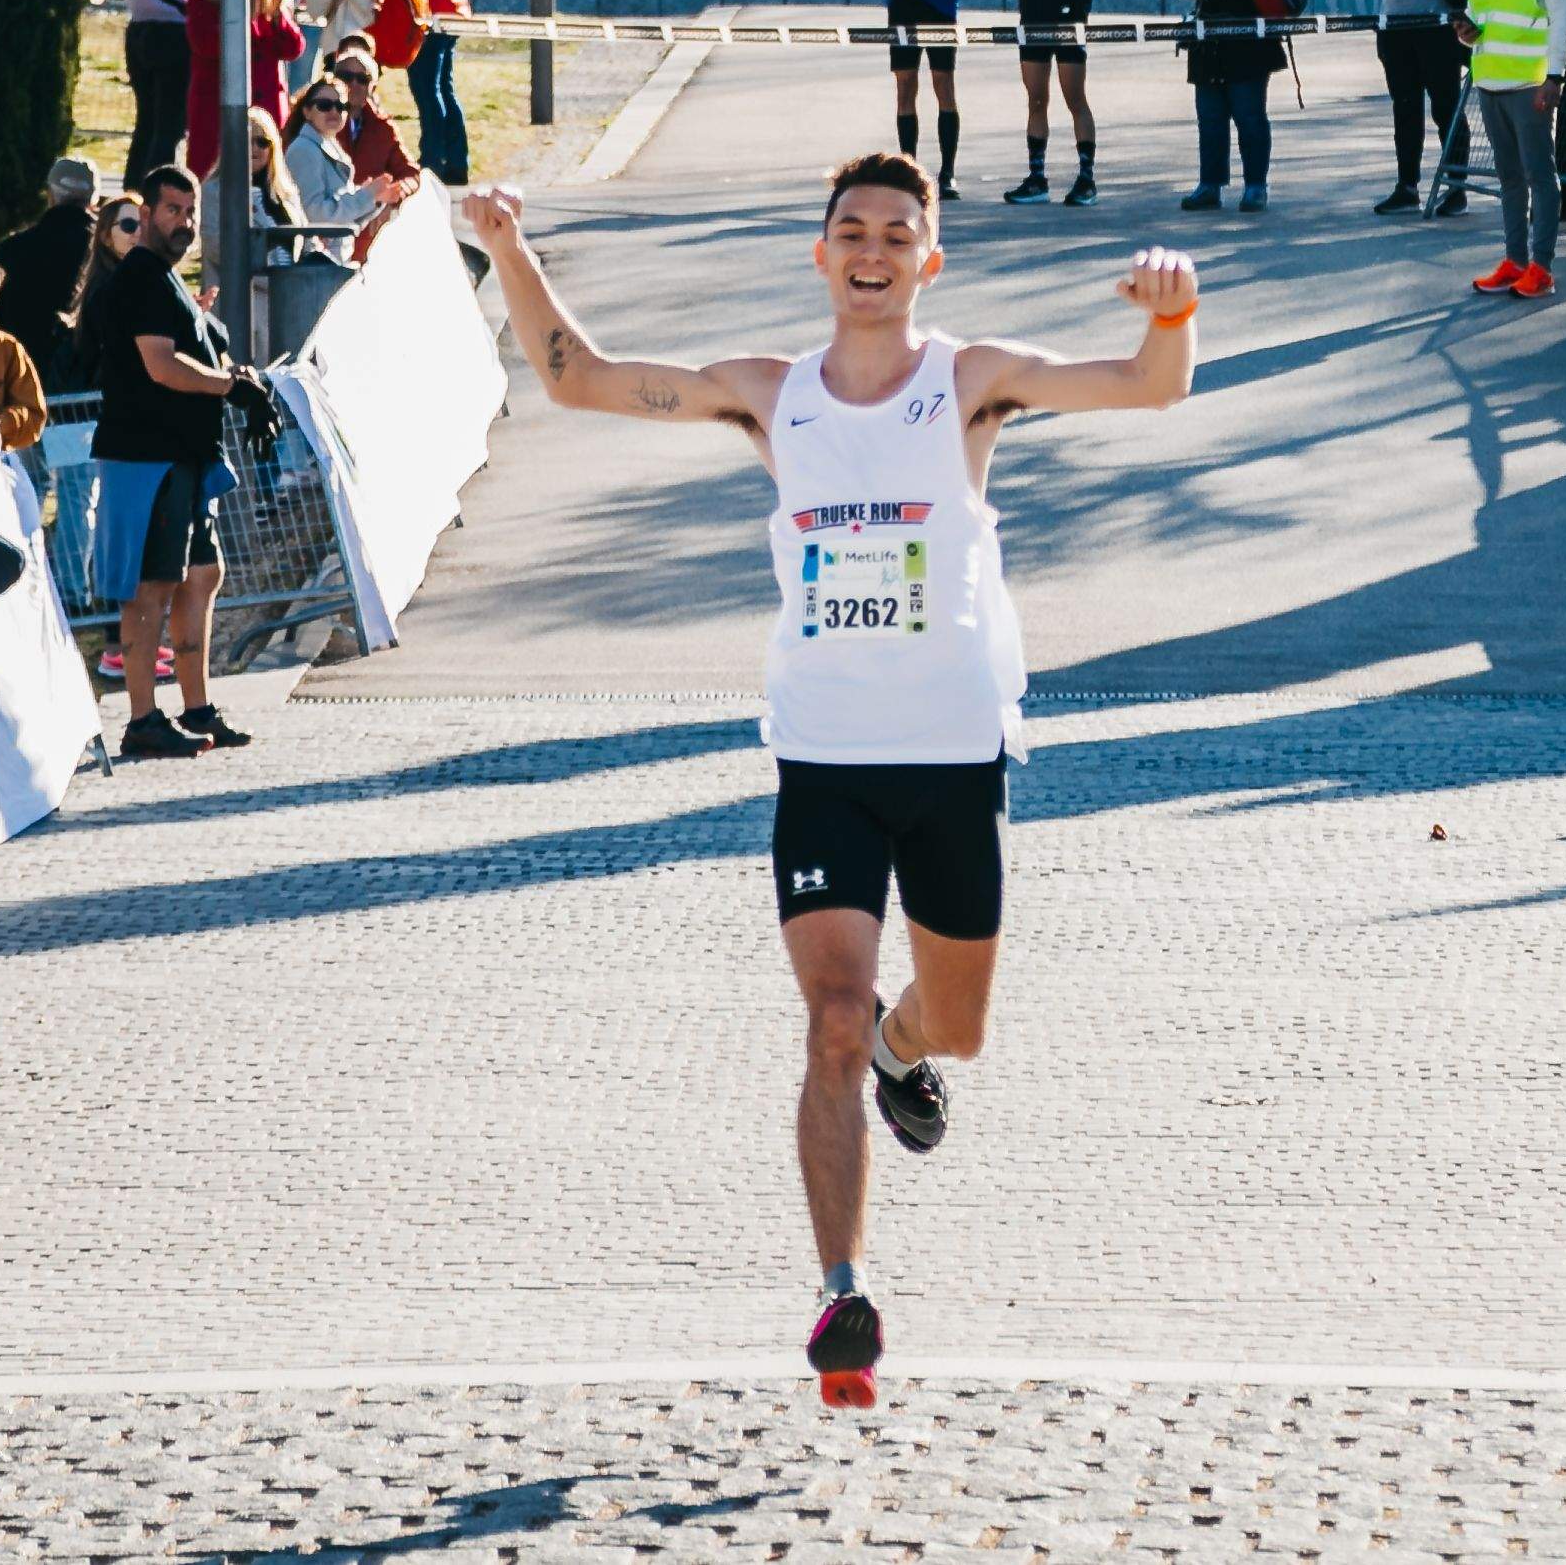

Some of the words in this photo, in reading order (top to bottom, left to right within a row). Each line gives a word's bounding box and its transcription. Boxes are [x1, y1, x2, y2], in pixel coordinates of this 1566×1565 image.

[904, 394, 946, 425] 97
[813, 503, 866, 527] TRUEKE
[870, 502, 903, 522] RUN
[845, 550, 899, 564] MetLife
[824, 596, 899, 629] 3262
